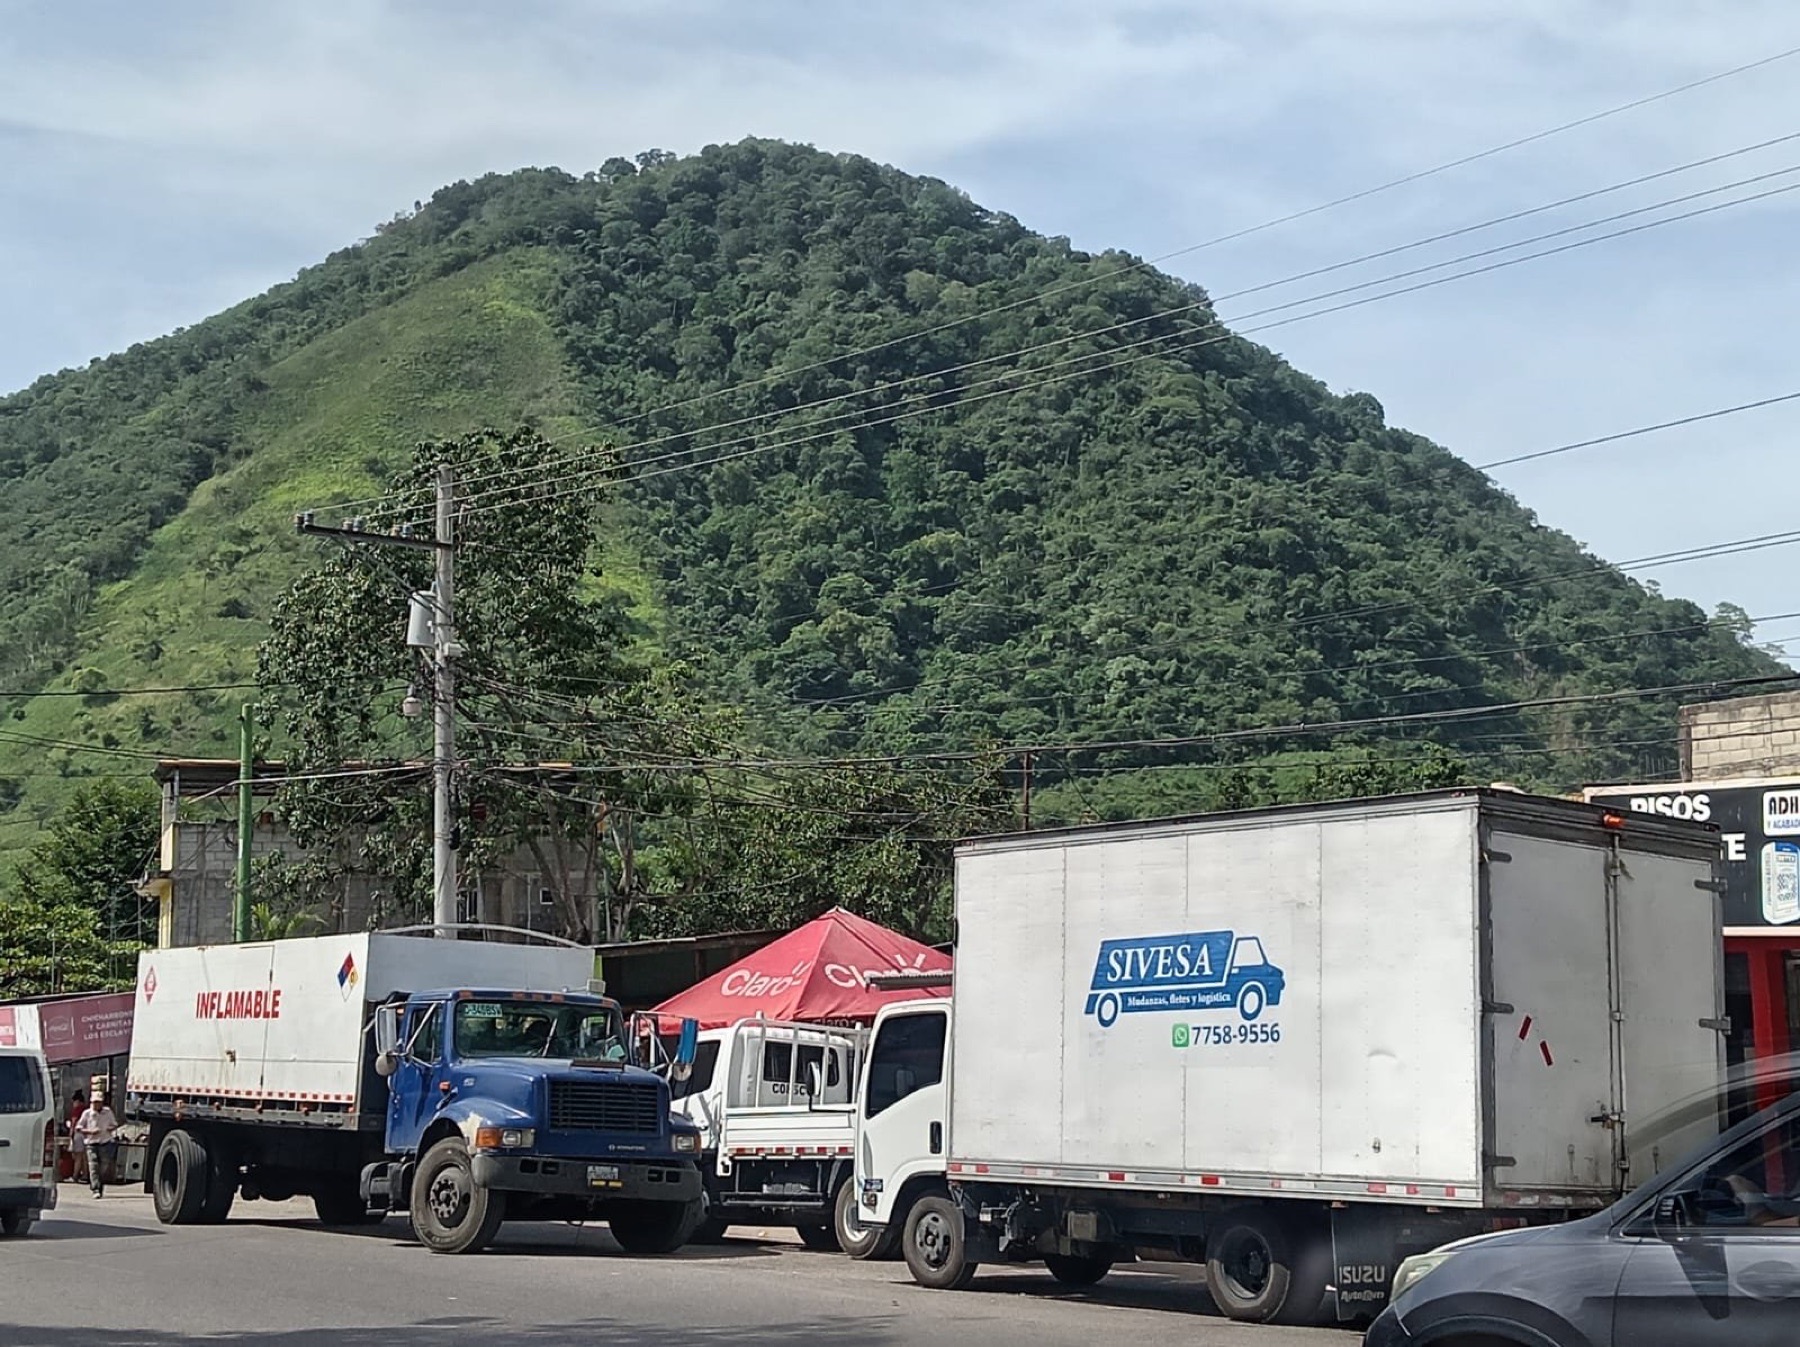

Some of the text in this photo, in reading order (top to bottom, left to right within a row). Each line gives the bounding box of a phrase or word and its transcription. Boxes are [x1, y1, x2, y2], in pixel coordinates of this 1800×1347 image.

[1106, 943, 1213, 982] SIVESA
[721, 968, 791, 997] Claro
[196, 989, 281, 1019] INFLAMABLE
[1191, 1023, 1281, 1045] 7758-9556
[1339, 1265, 1385, 1284] ISUZU
